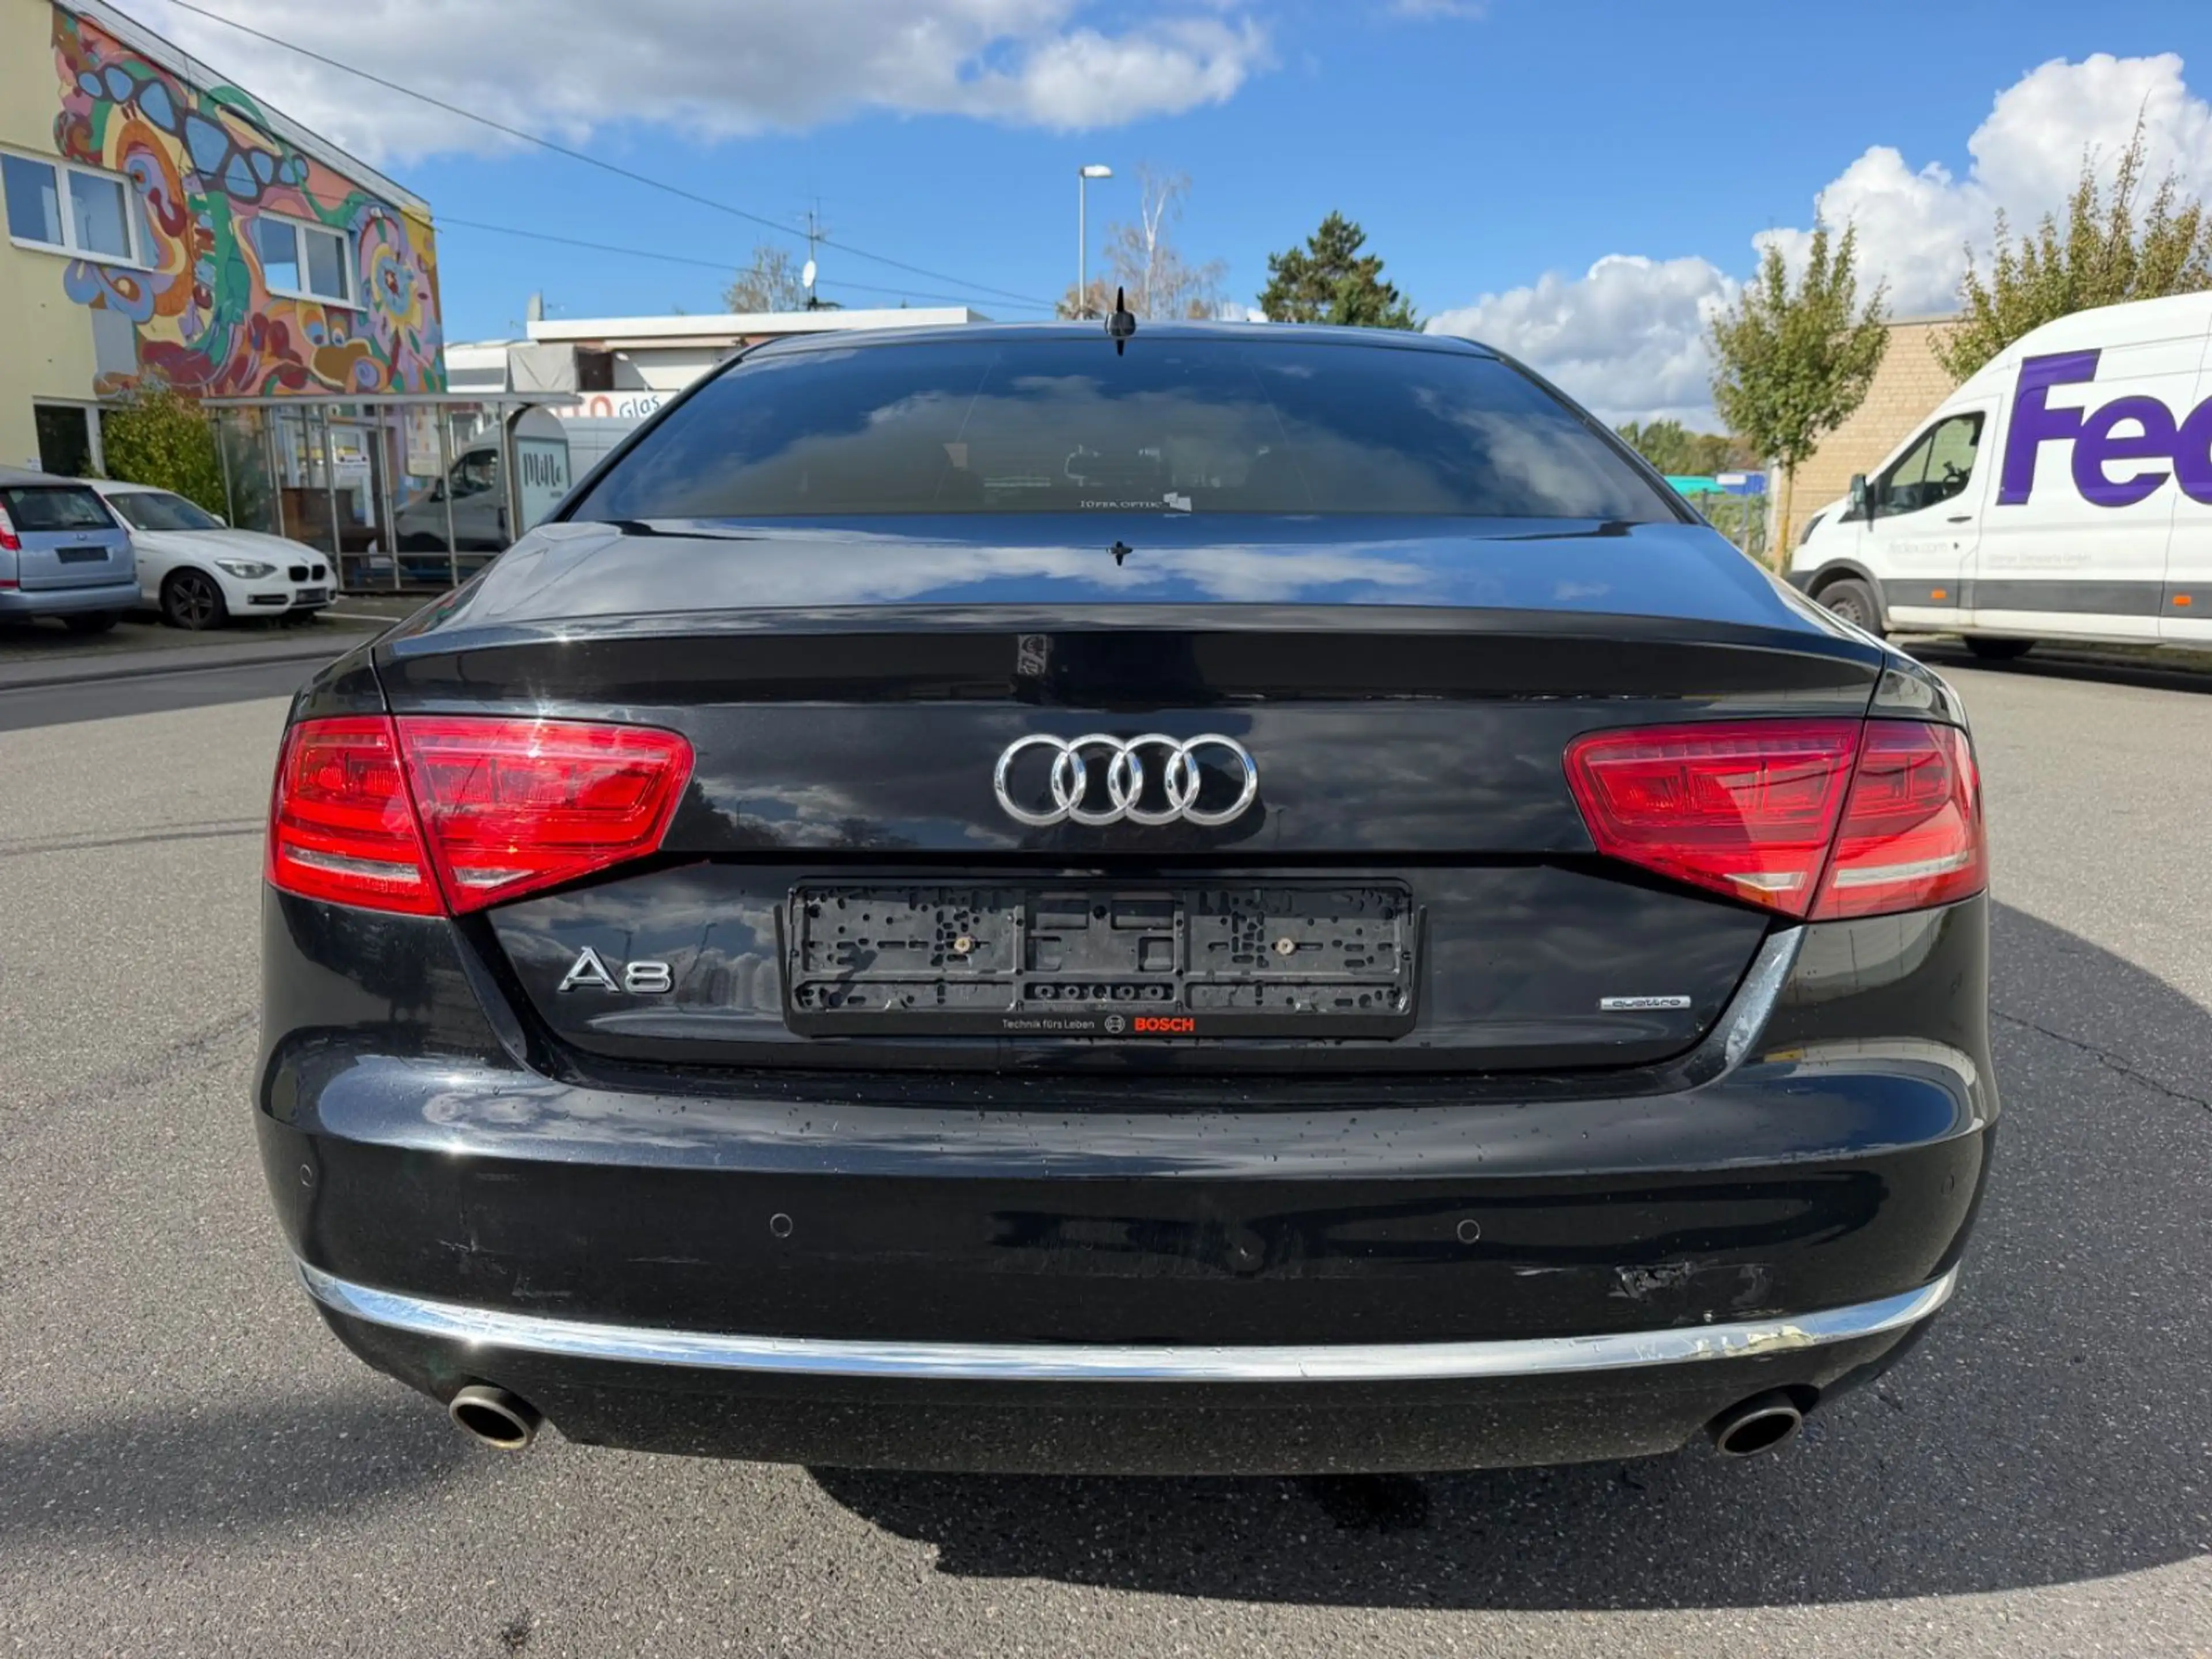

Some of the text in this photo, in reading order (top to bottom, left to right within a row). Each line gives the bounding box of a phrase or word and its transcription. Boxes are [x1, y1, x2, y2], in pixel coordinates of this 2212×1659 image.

[619, 395, 661, 418] Glas
[558, 945, 671, 993] A8
[1002, 1018, 1041, 1029] Technik
[1064, 1018, 1094, 1029] Leben
[1134, 1017, 1195, 1031] BOSCH
